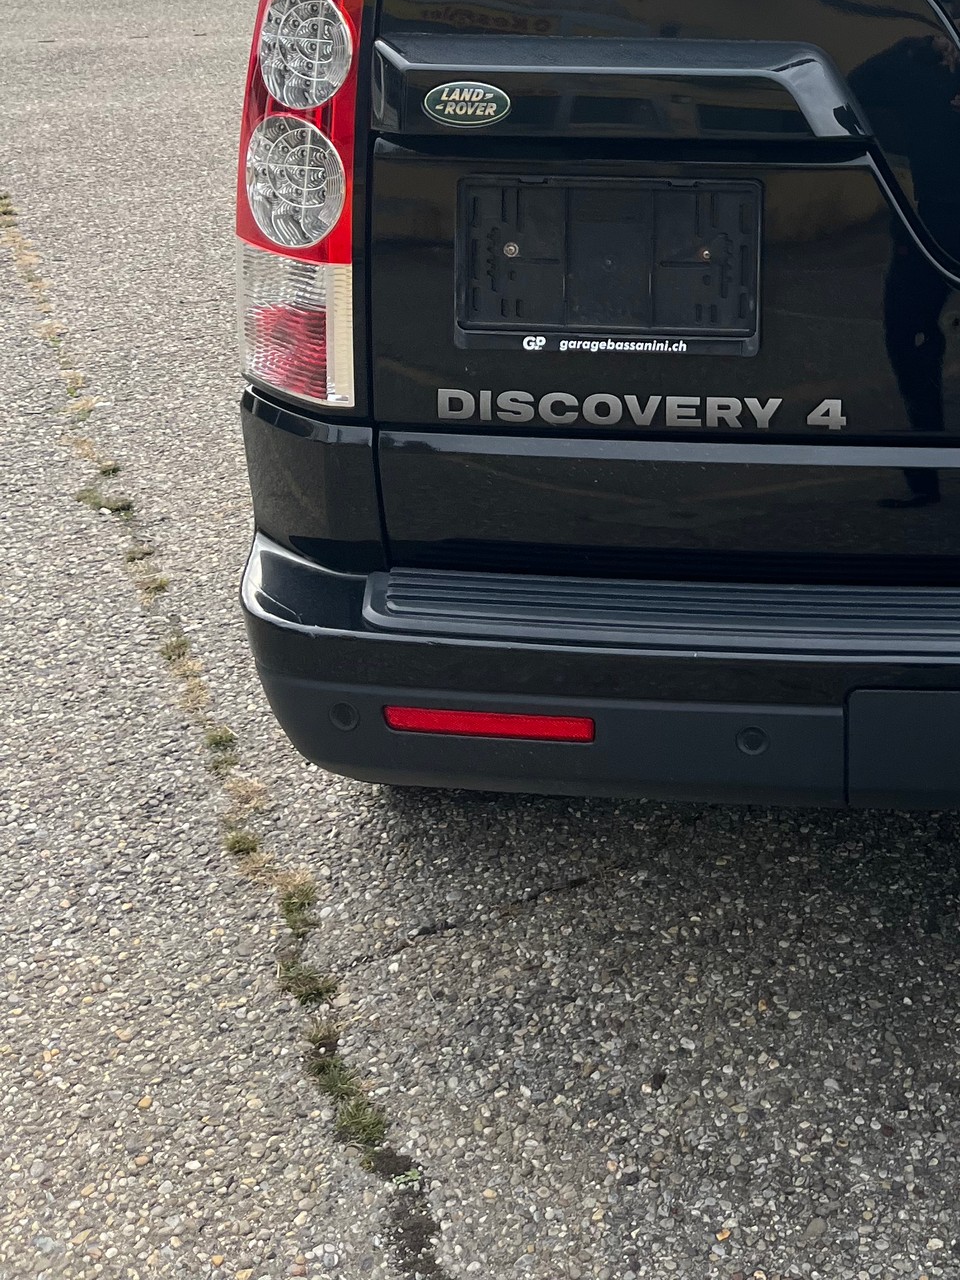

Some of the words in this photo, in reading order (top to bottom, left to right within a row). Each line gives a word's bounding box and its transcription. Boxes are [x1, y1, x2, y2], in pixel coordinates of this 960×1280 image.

[441, 87, 485, 101] LAND
[444, 101, 497, 116] ROVER
[559, 338, 687, 352] garagebassanini.ch
[437, 388, 783, 428] DISCOVERY
[806, 398, 847, 430] 4
